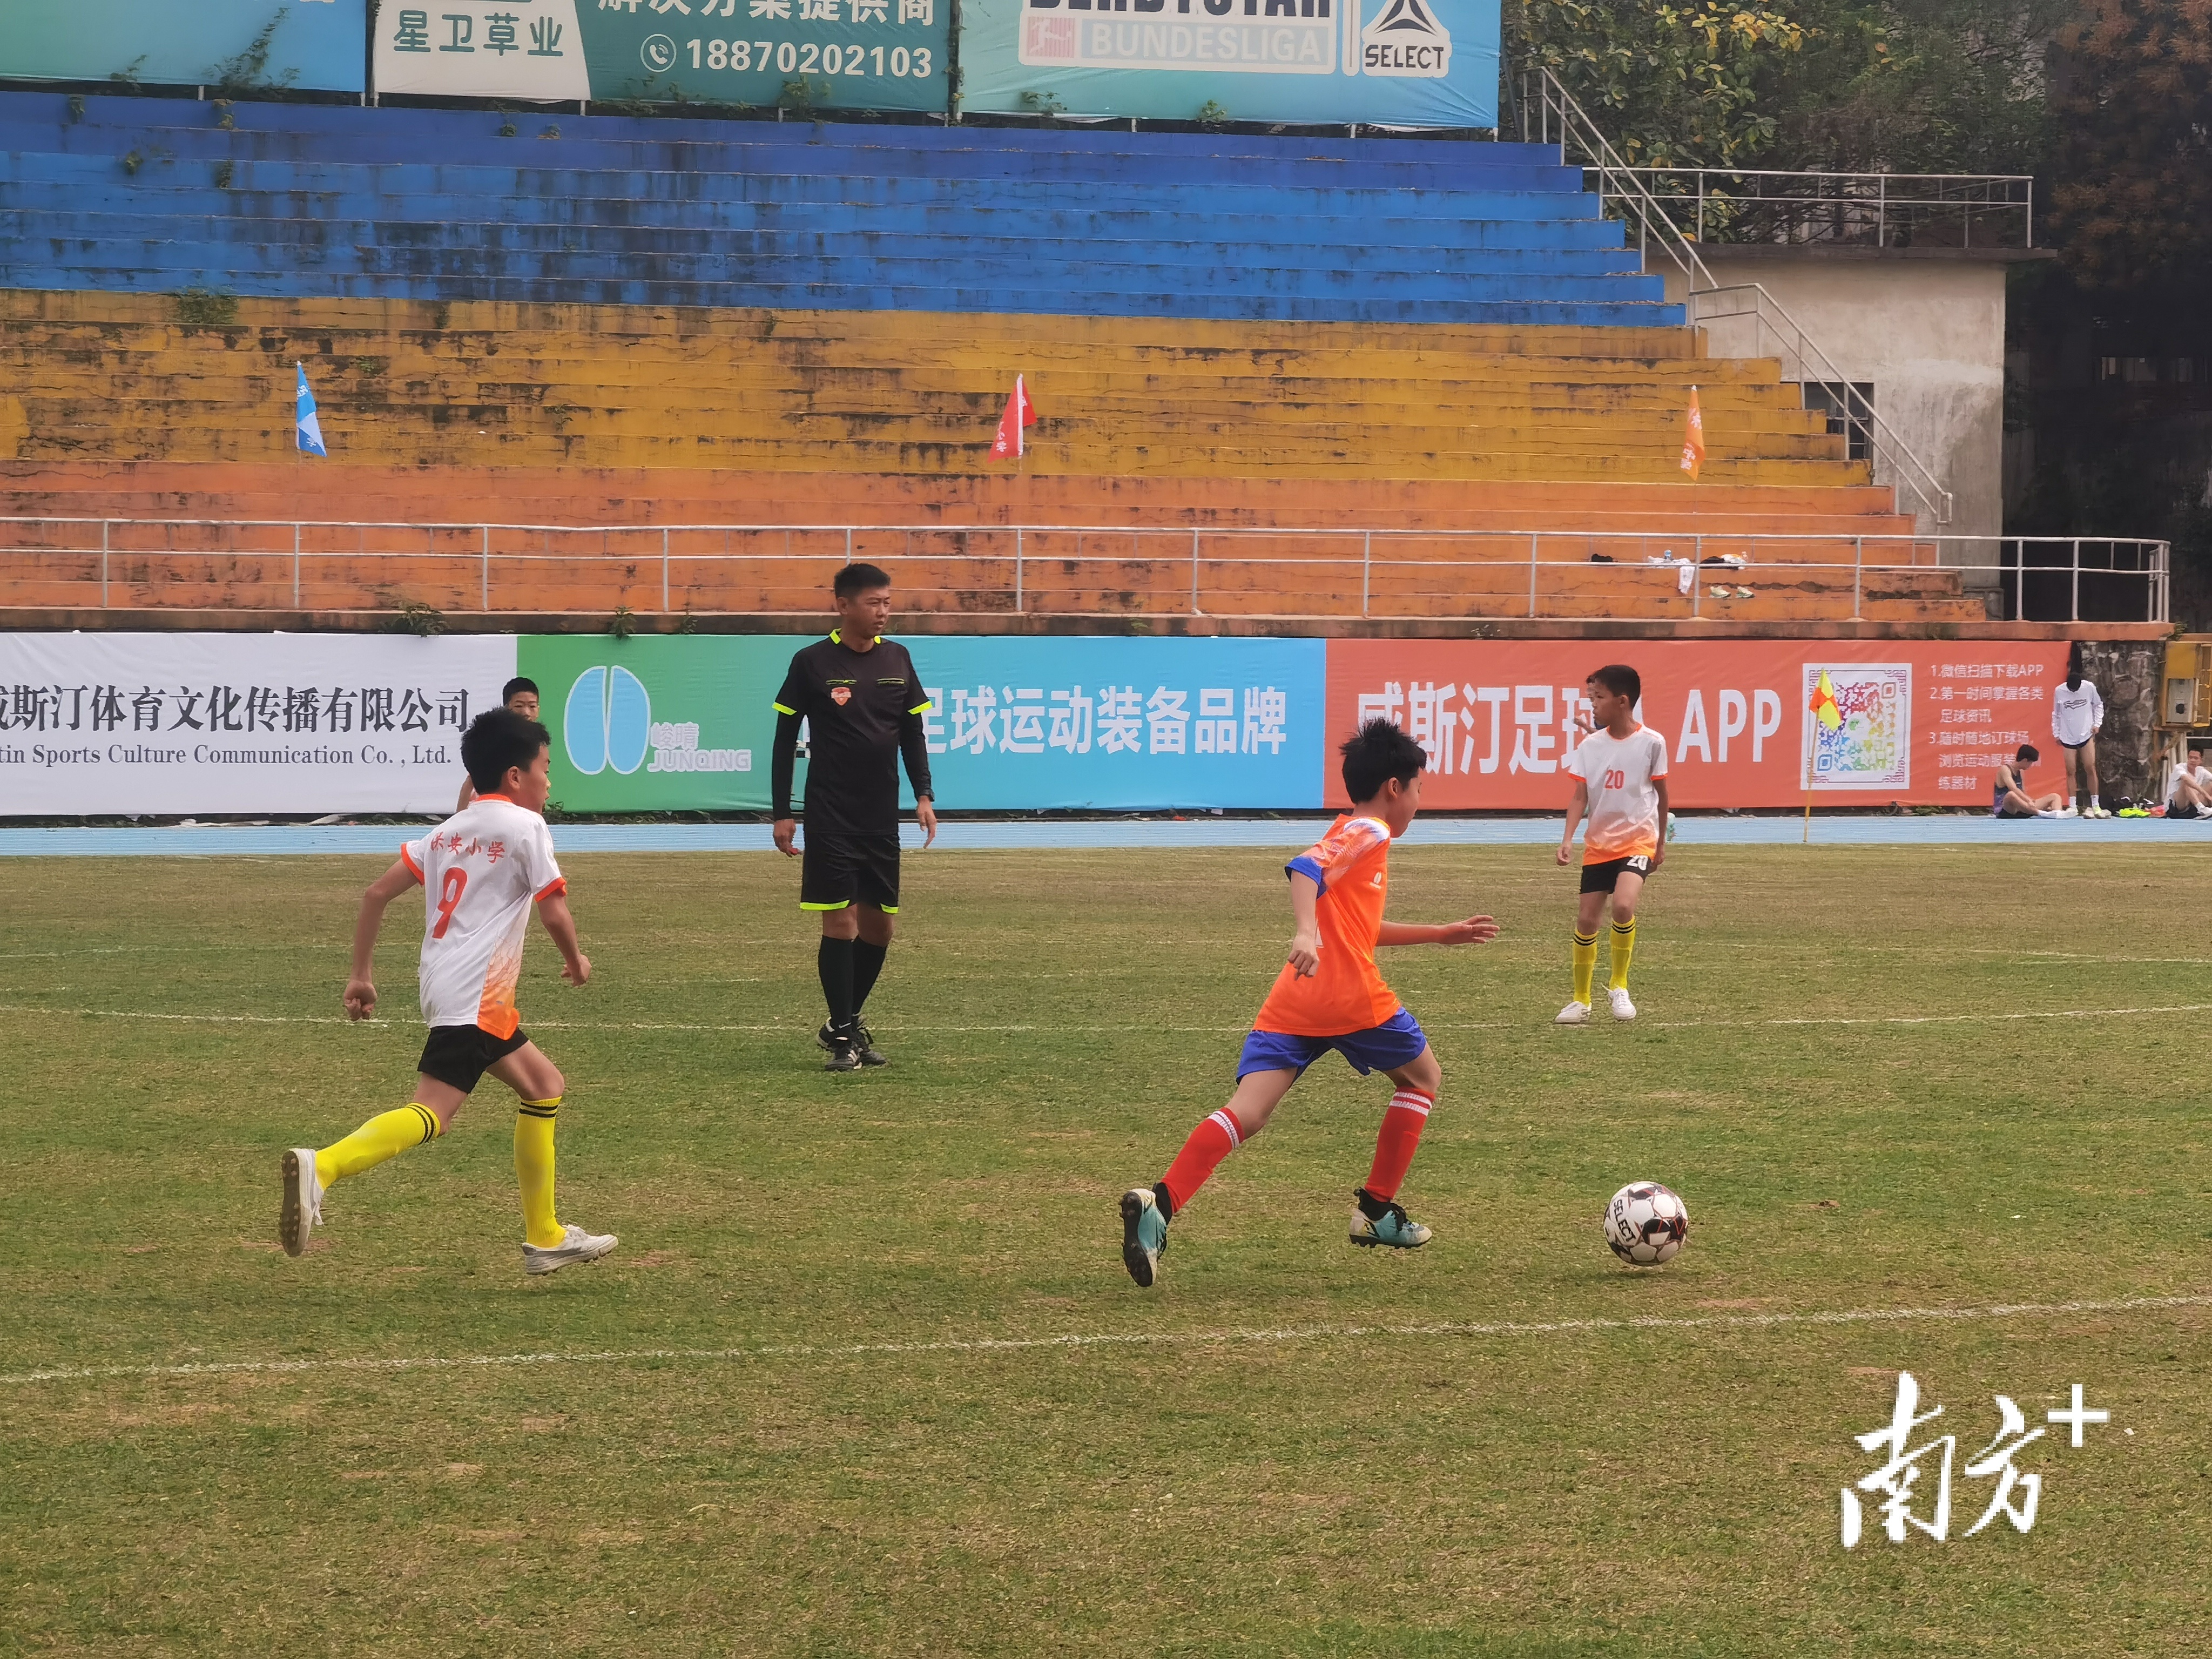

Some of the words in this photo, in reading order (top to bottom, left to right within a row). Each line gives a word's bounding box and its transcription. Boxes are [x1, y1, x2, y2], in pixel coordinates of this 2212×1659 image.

[393, 12, 564, 57] 星卫草业
[1090, 22, 1322, 63] BUNDESLIGA
[686, 38, 932, 78] 18870202103
[1365, 44, 1445, 70] SELECT
[0, 685, 469, 732] 斯汀体育文化传播有限公司
[1675, 689, 1782, 763] APP
[32, 744, 101, 767] Sports
[108, 745, 186, 764] Culture
[194, 744, 354, 764] Communication
[412, 745, 451, 764] Ltd.
[647, 750, 752, 772] JUNQING
[1604, 769, 1624, 790] 20
[1627, 855, 1649, 871] 20
[432, 867, 468, 939] 9
[1614, 1199, 1636, 1242] SELECT
